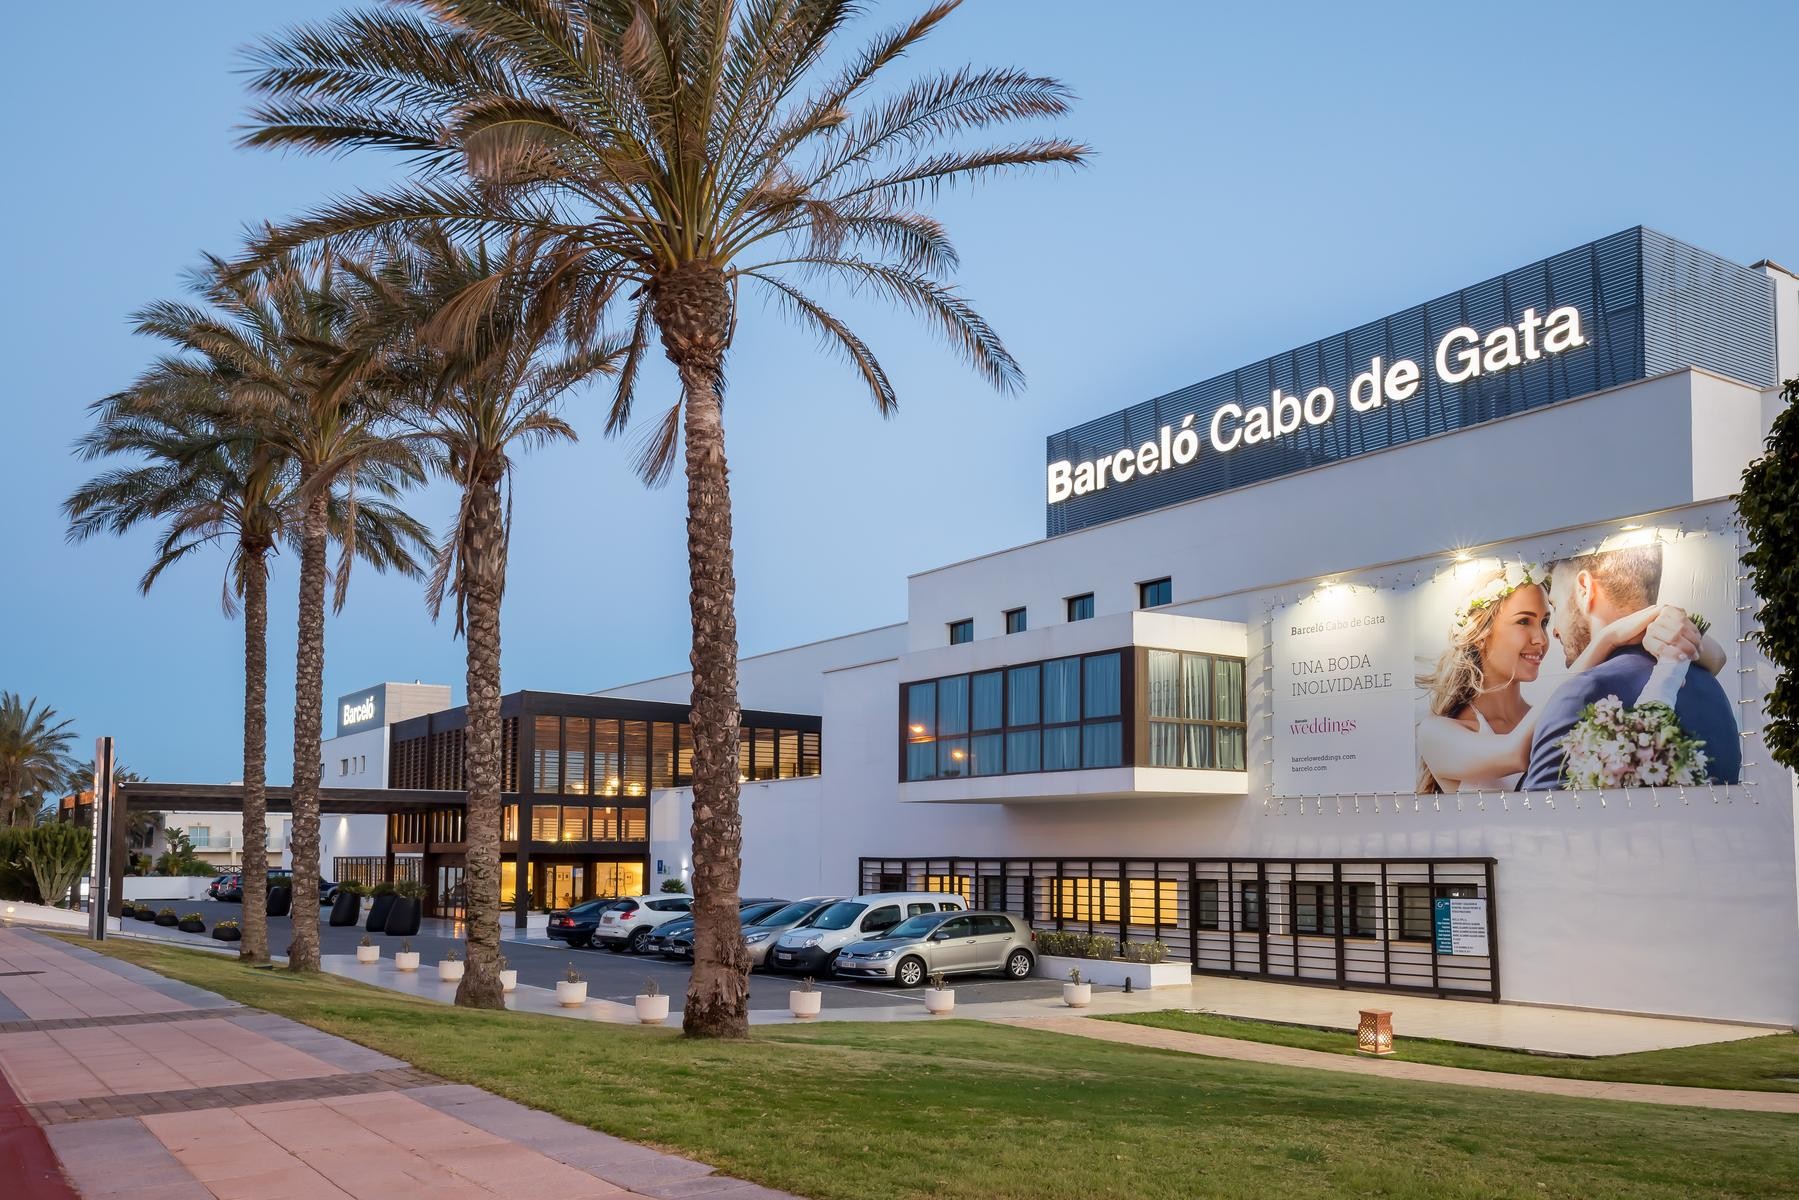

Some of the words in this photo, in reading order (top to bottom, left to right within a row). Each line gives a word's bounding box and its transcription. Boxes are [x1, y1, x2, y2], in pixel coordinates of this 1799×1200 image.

[1047, 414, 1200, 504] Barceló
[1210, 386, 1335, 453] Cabo
[1350, 356, 1420, 413] de
[1435, 306, 1584, 384] Gata
[1350, 617, 1362, 628] de
[1363, 615, 1386, 626] Gata
[1292, 659, 1325, 676] UNA
[1328, 654, 1372, 672] BODA
[1292, 673, 1393, 697] INOLVIDABLE
[343, 695, 375, 726] Barceló
[1290, 717, 1357, 736] weddings
[1291, 754, 1357, 762] barceloweddings.com
